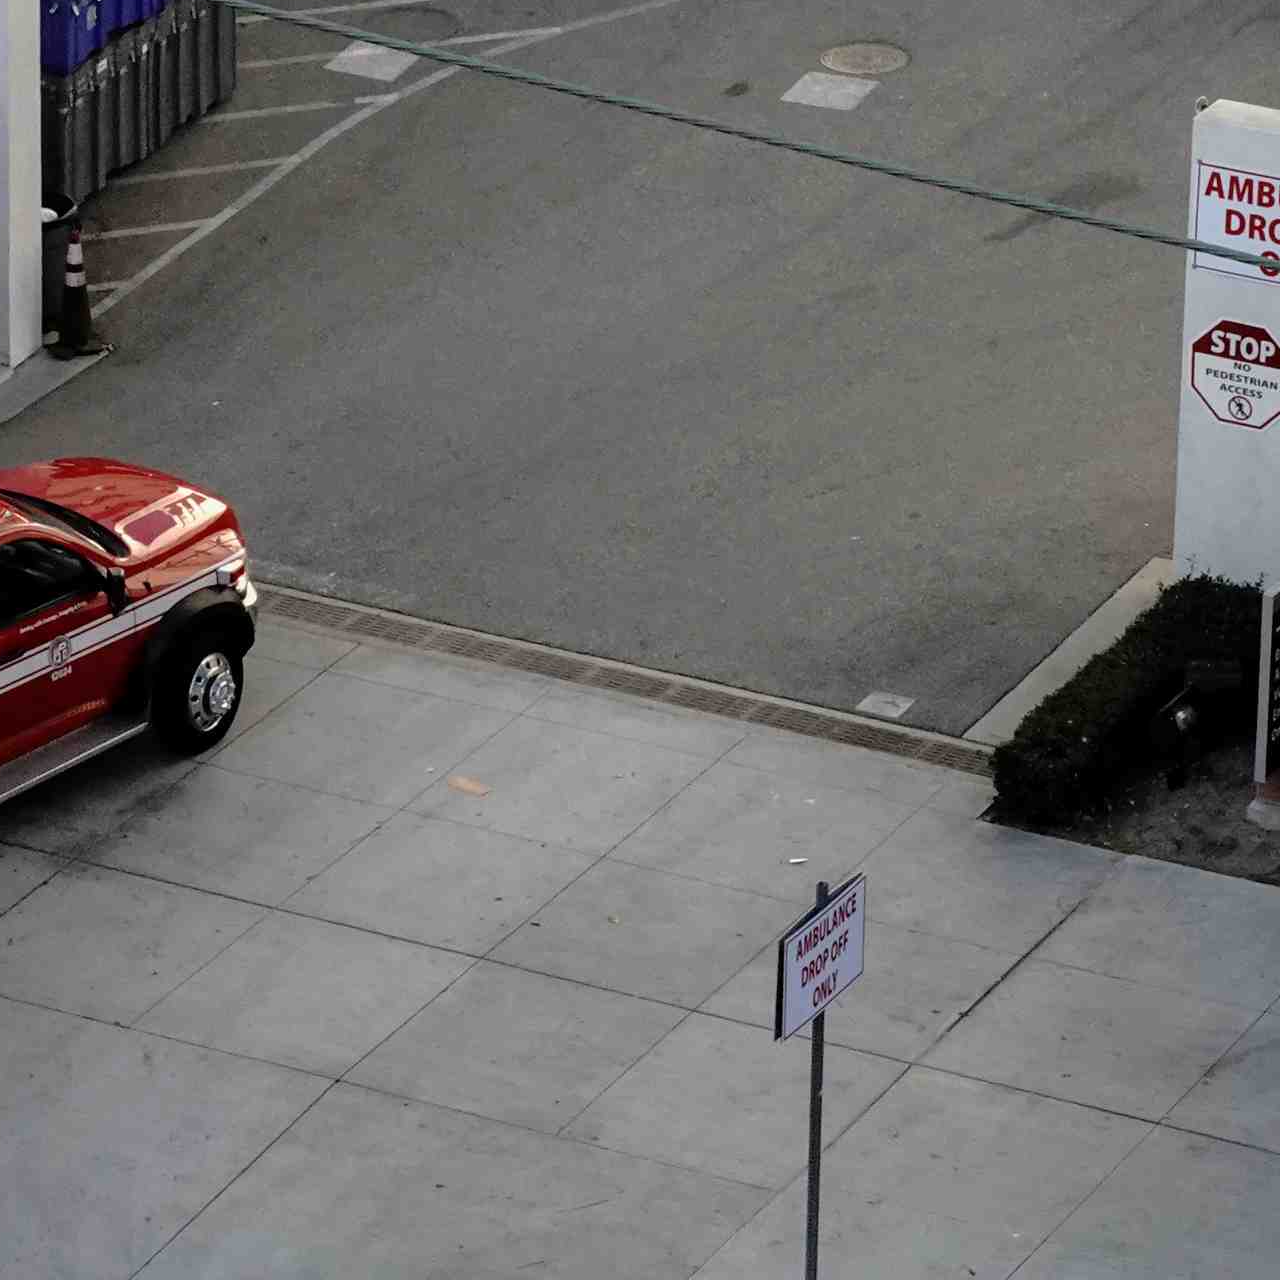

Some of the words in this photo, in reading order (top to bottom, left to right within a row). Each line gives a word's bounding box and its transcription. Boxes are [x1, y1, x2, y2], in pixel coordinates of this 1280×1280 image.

[1211, 330, 1276, 363] STOP
[1206, 368, 1279, 390] PEDESTRIAN
[1232, 362, 1252, 372] NO
[1220, 383, 1263, 399] ACCESS
[796, 892, 857, 961] AMBULANCE
[801, 947, 830, 988] DROP
[831, 930, 849, 962] OFF
[812, 969, 839, 1008] ONLY
